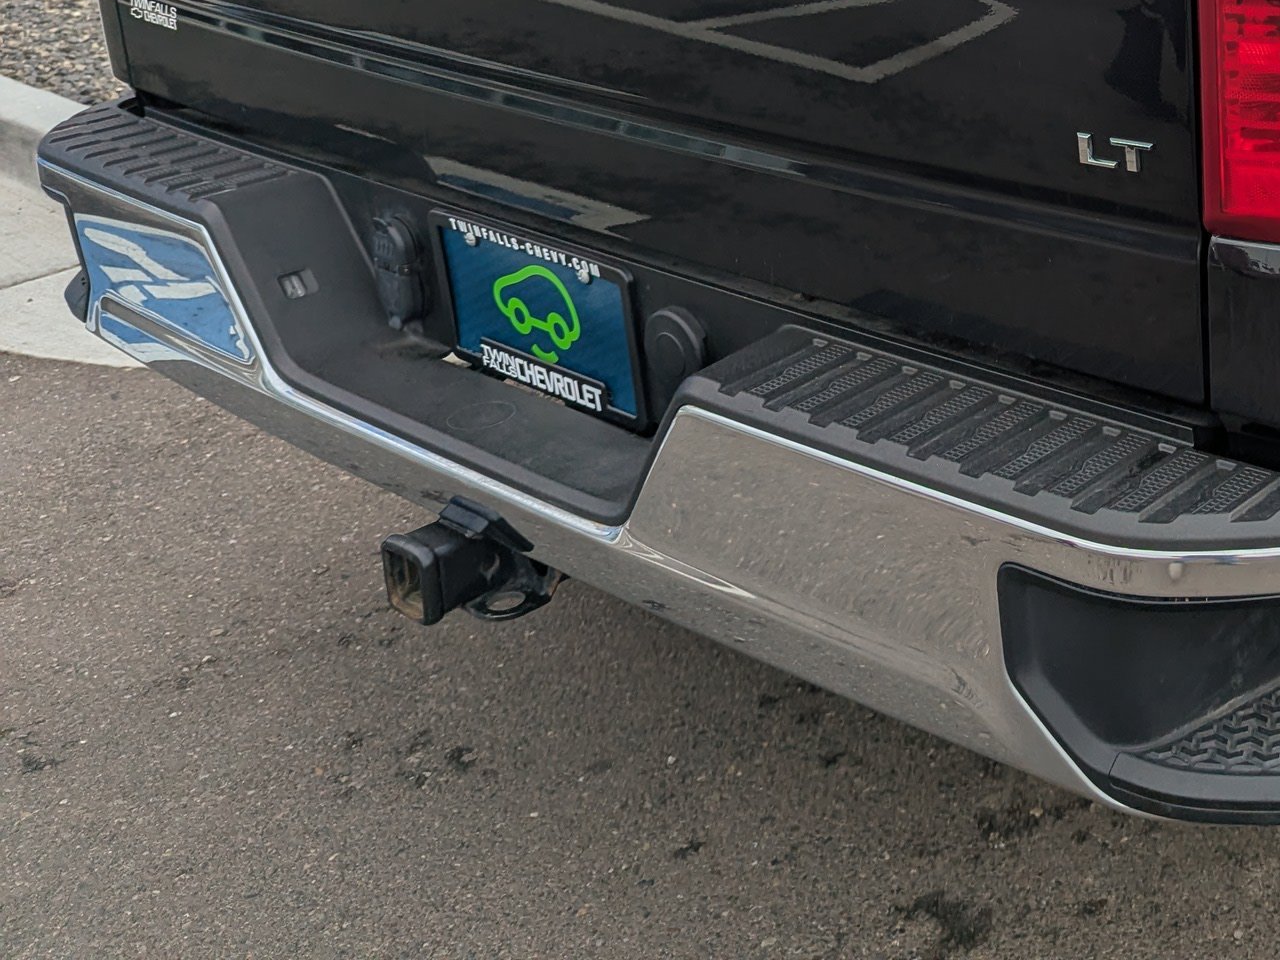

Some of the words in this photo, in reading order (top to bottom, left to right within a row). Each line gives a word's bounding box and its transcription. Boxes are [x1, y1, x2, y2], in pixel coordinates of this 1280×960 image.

[1076, 132, 1154, 172] LT
[480, 343, 516, 367] TWIN
[482, 355, 518, 379] FALLS
[514, 357, 603, 412] CHEVROLET
